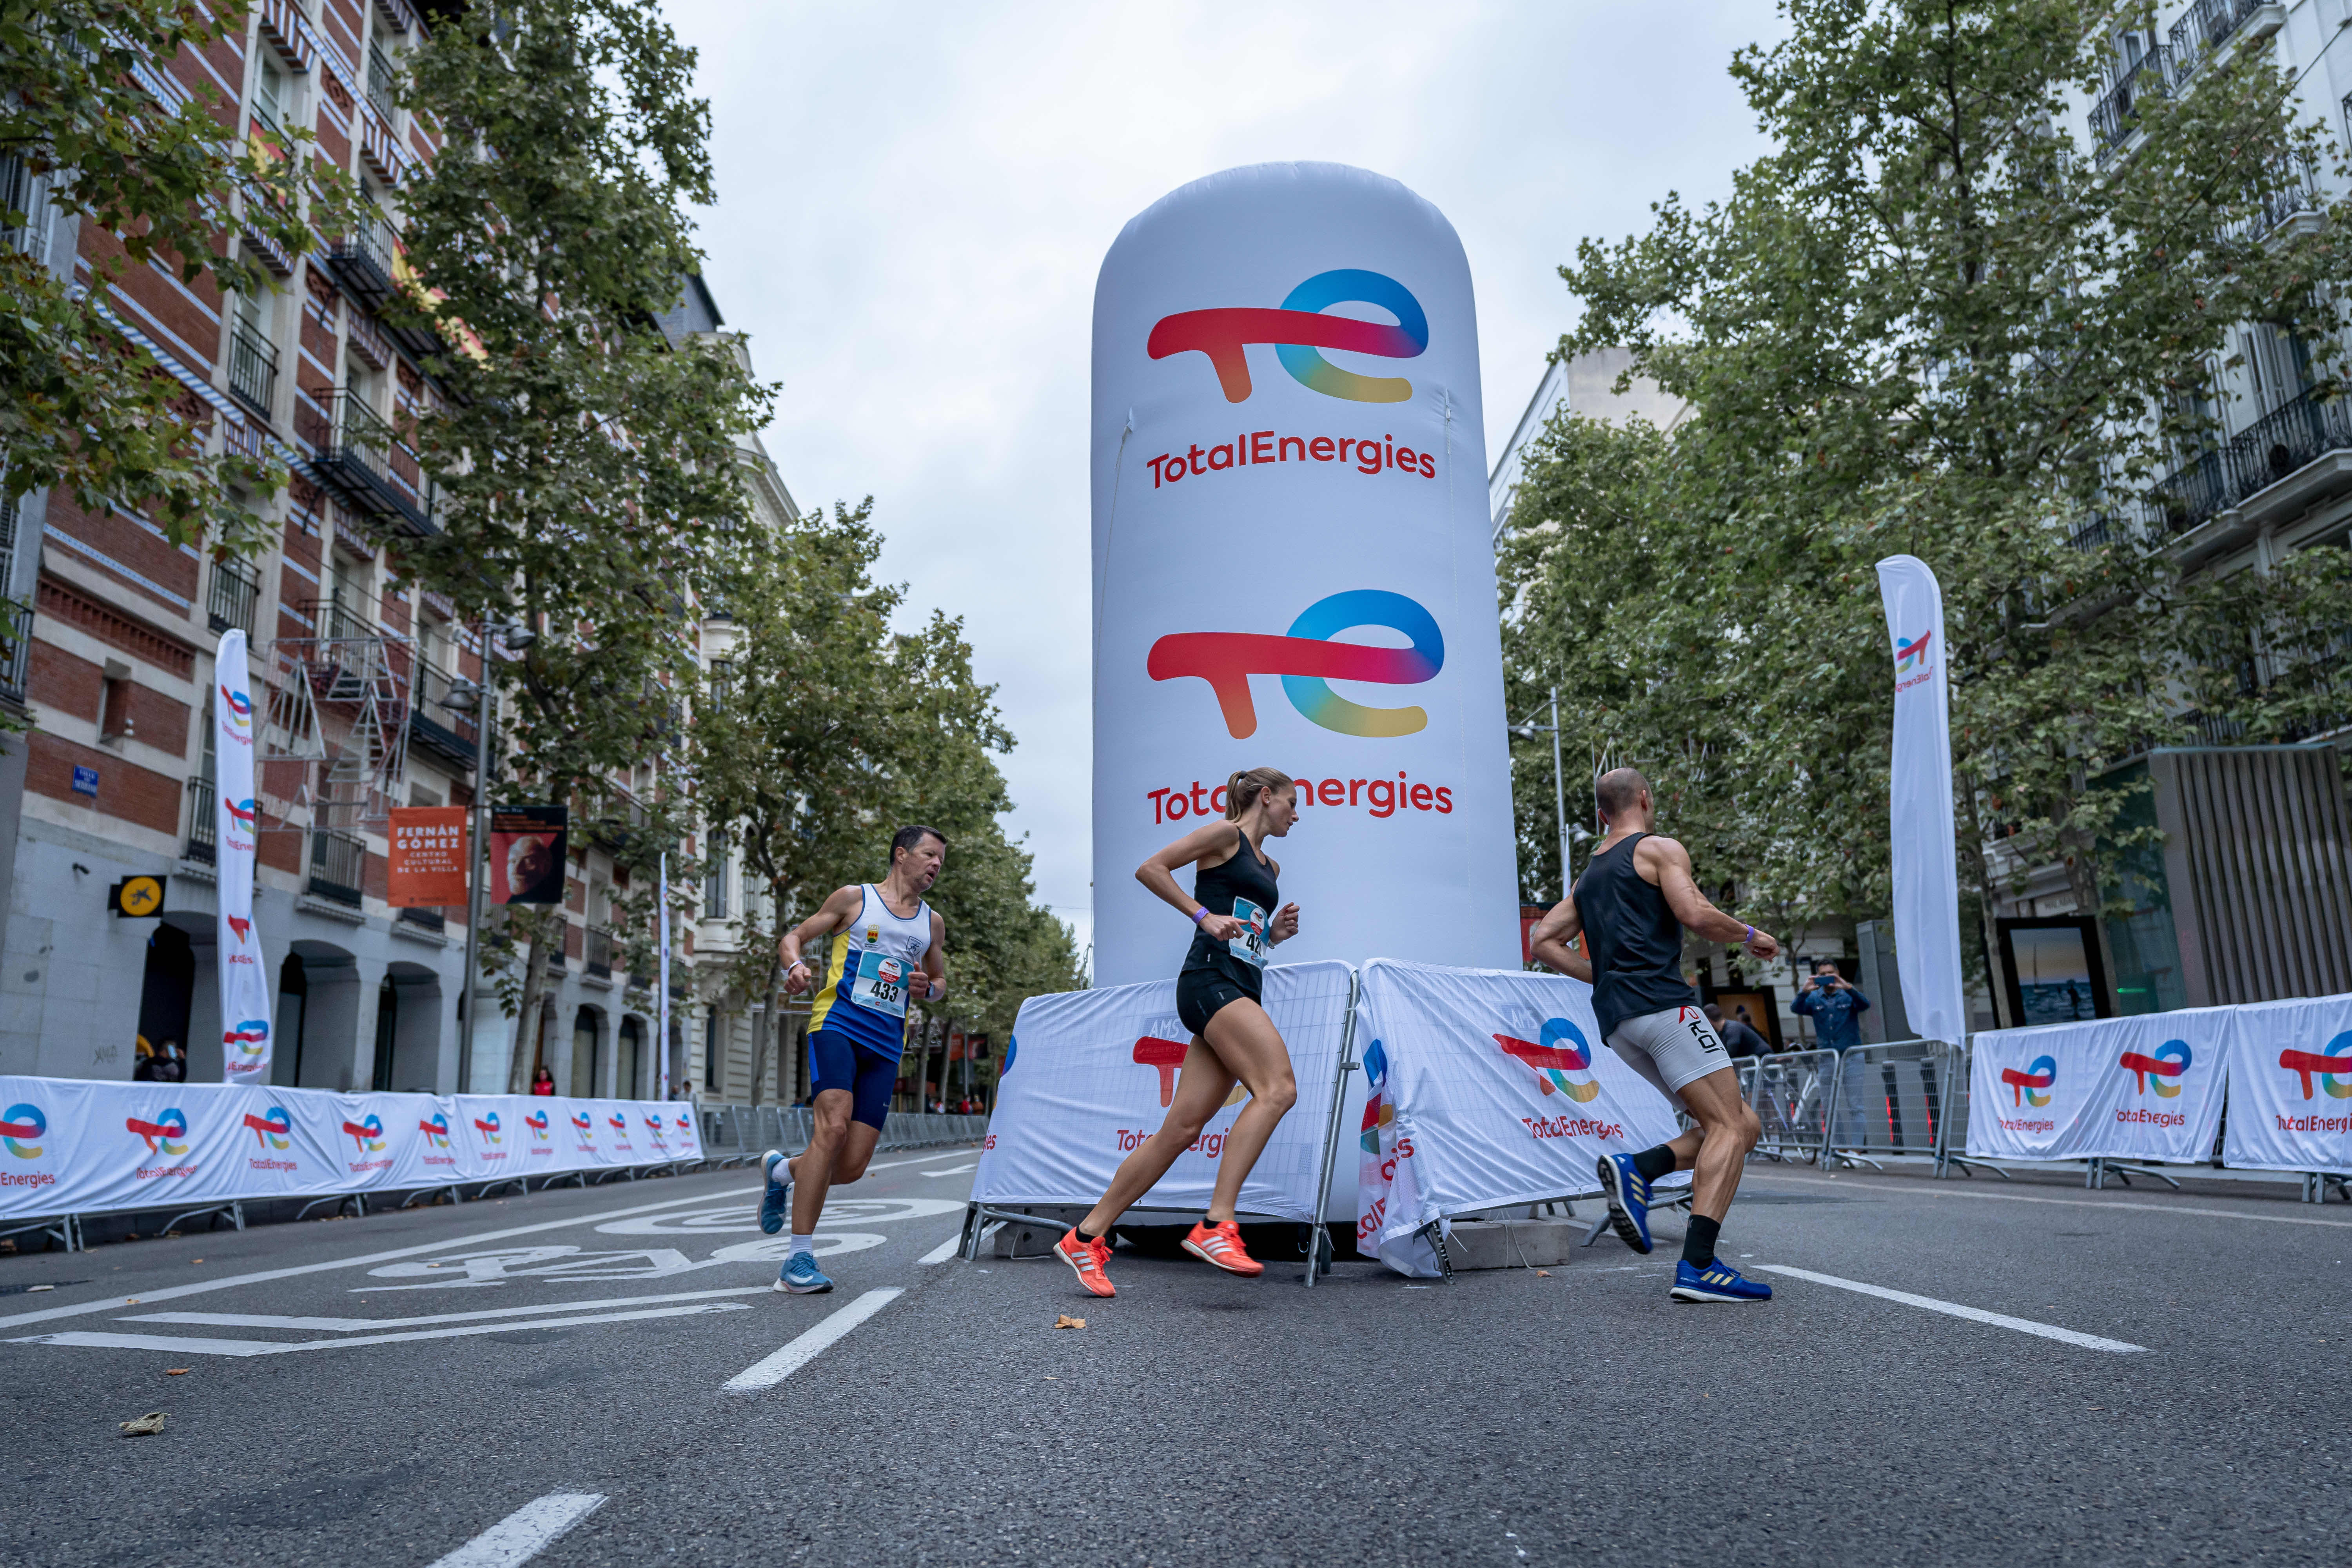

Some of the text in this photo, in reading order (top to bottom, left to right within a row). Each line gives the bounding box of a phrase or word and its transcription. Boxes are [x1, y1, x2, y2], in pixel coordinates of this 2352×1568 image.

[1147, 431, 1436, 489] TotalEnergies
[397, 824, 459, 837] FERNÁN
[397, 837, 459, 849] GÓMEZ
[870, 981, 899, 1003] 433
[1149, 1018, 1180, 1038] AMS
